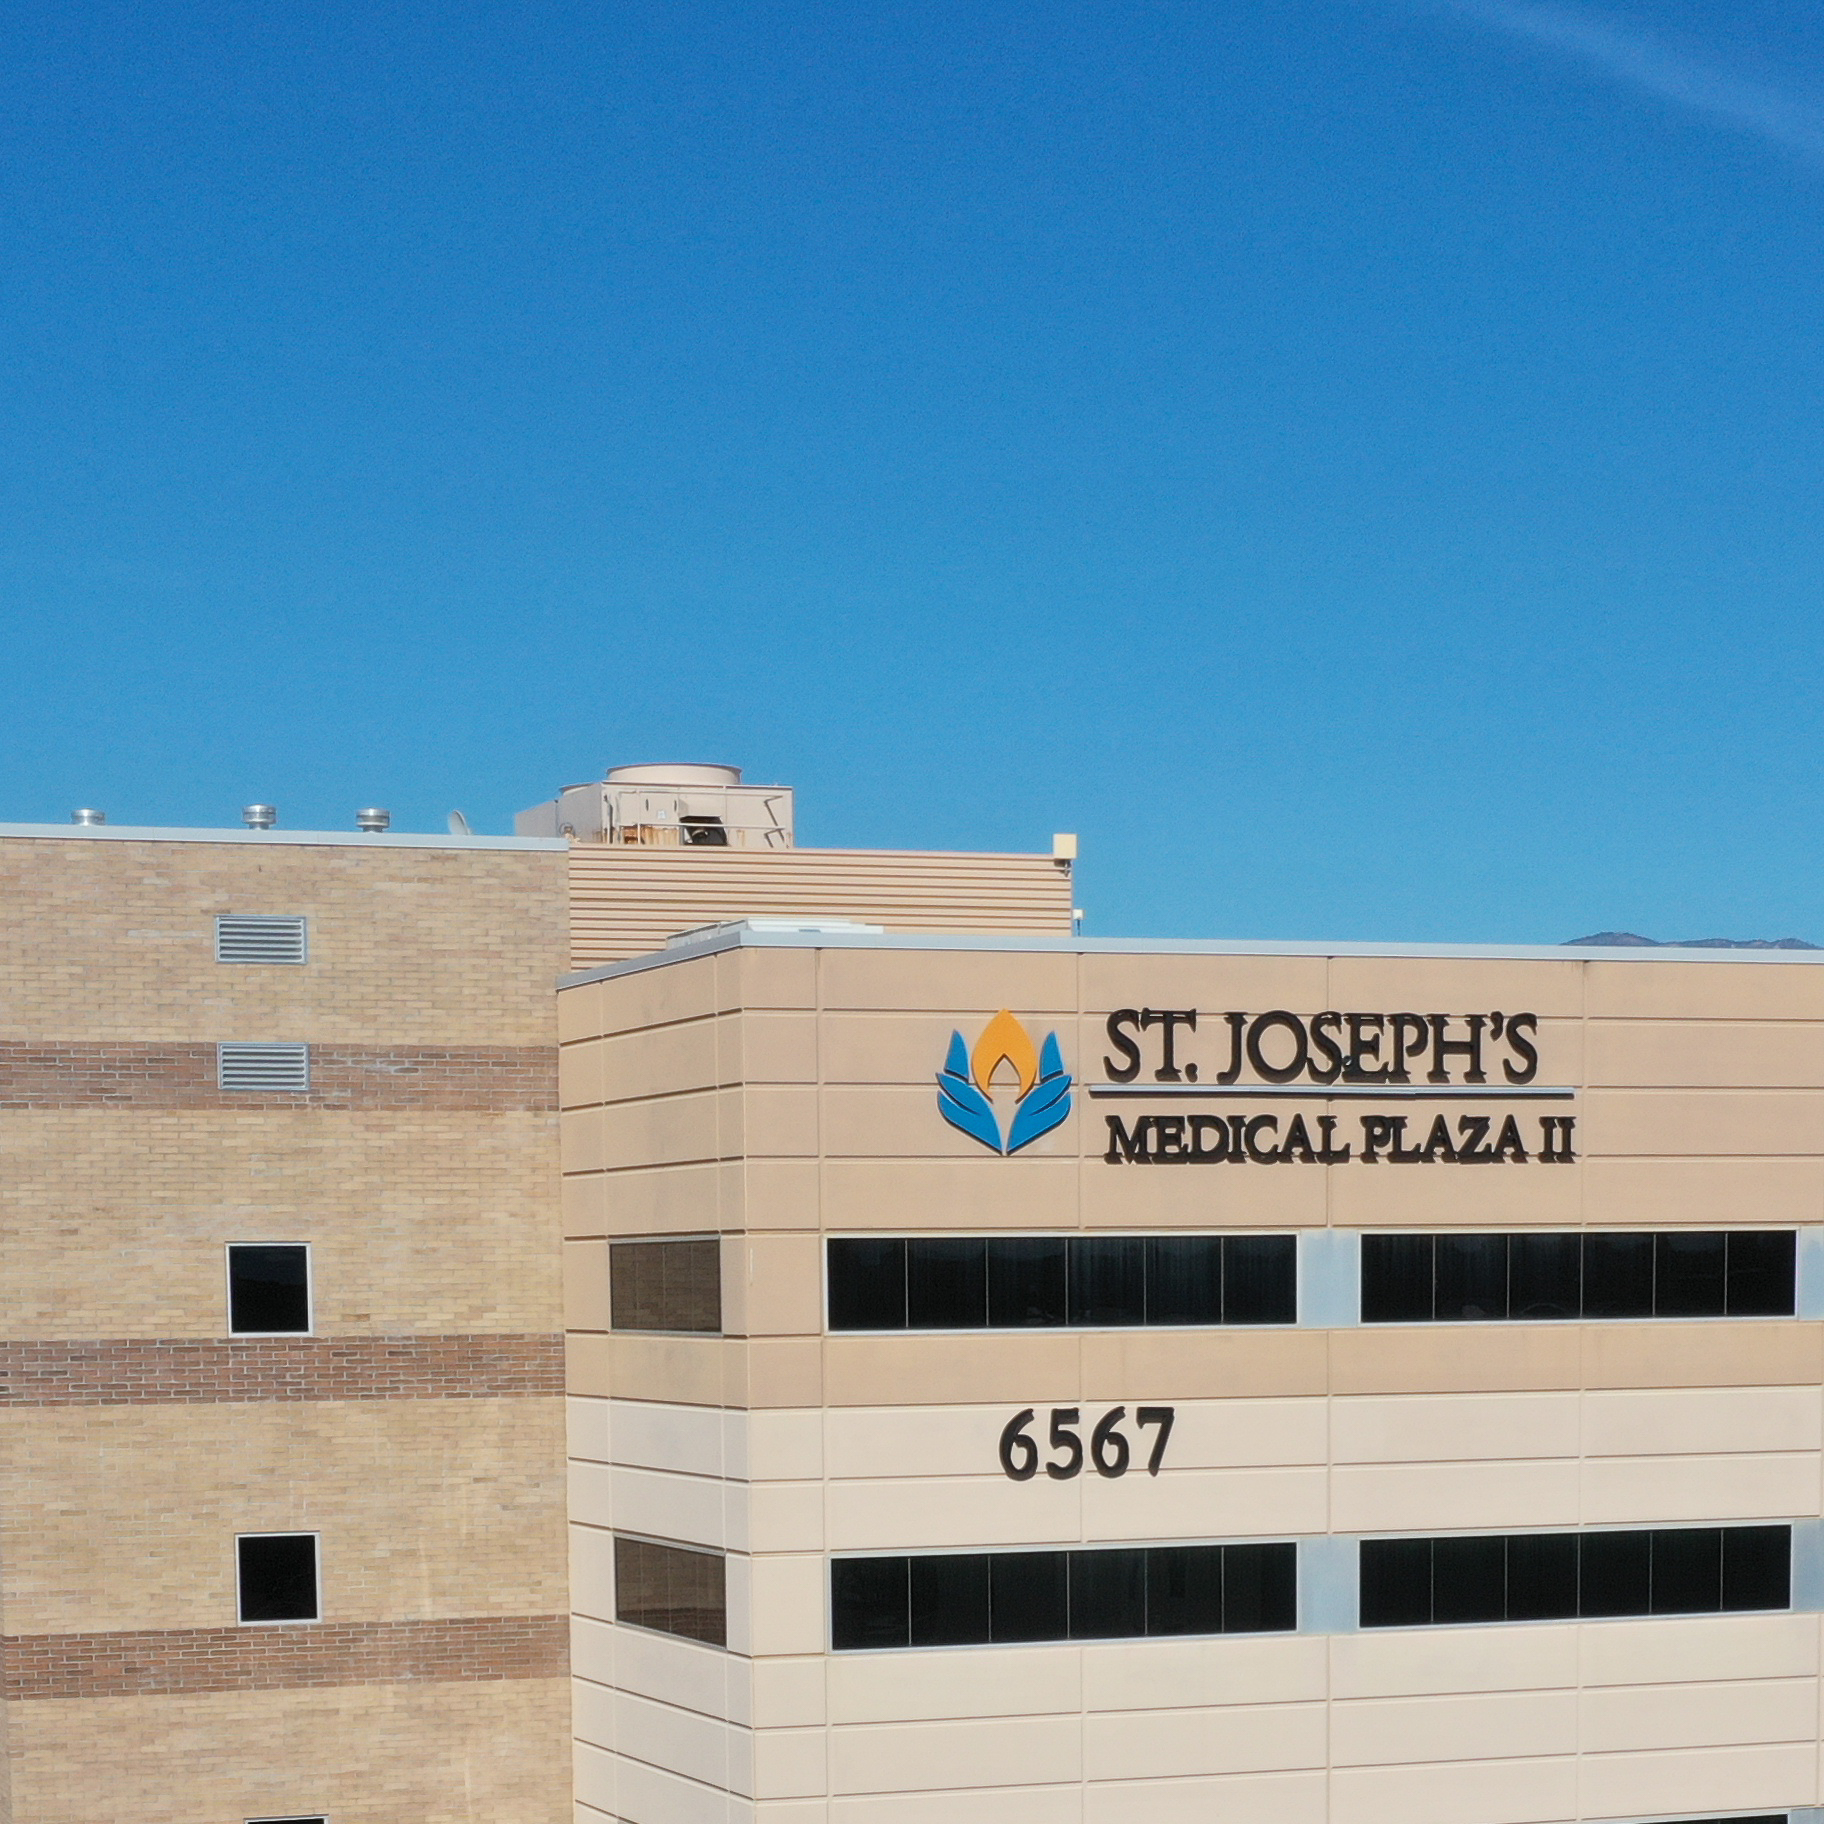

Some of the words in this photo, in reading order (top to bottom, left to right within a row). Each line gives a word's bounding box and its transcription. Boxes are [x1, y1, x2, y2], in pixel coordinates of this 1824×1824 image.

[1104, 1008, 1198, 1082] ST.
[1217, 1010, 1538, 1084] JOSEPH'S
[1104, 1113, 1350, 1165] MEDICAL
[1361, 1113, 1529, 1165] PLAZA
[1538, 1116, 1576, 1164] II
[999, 1406, 1175, 1481] 6567
